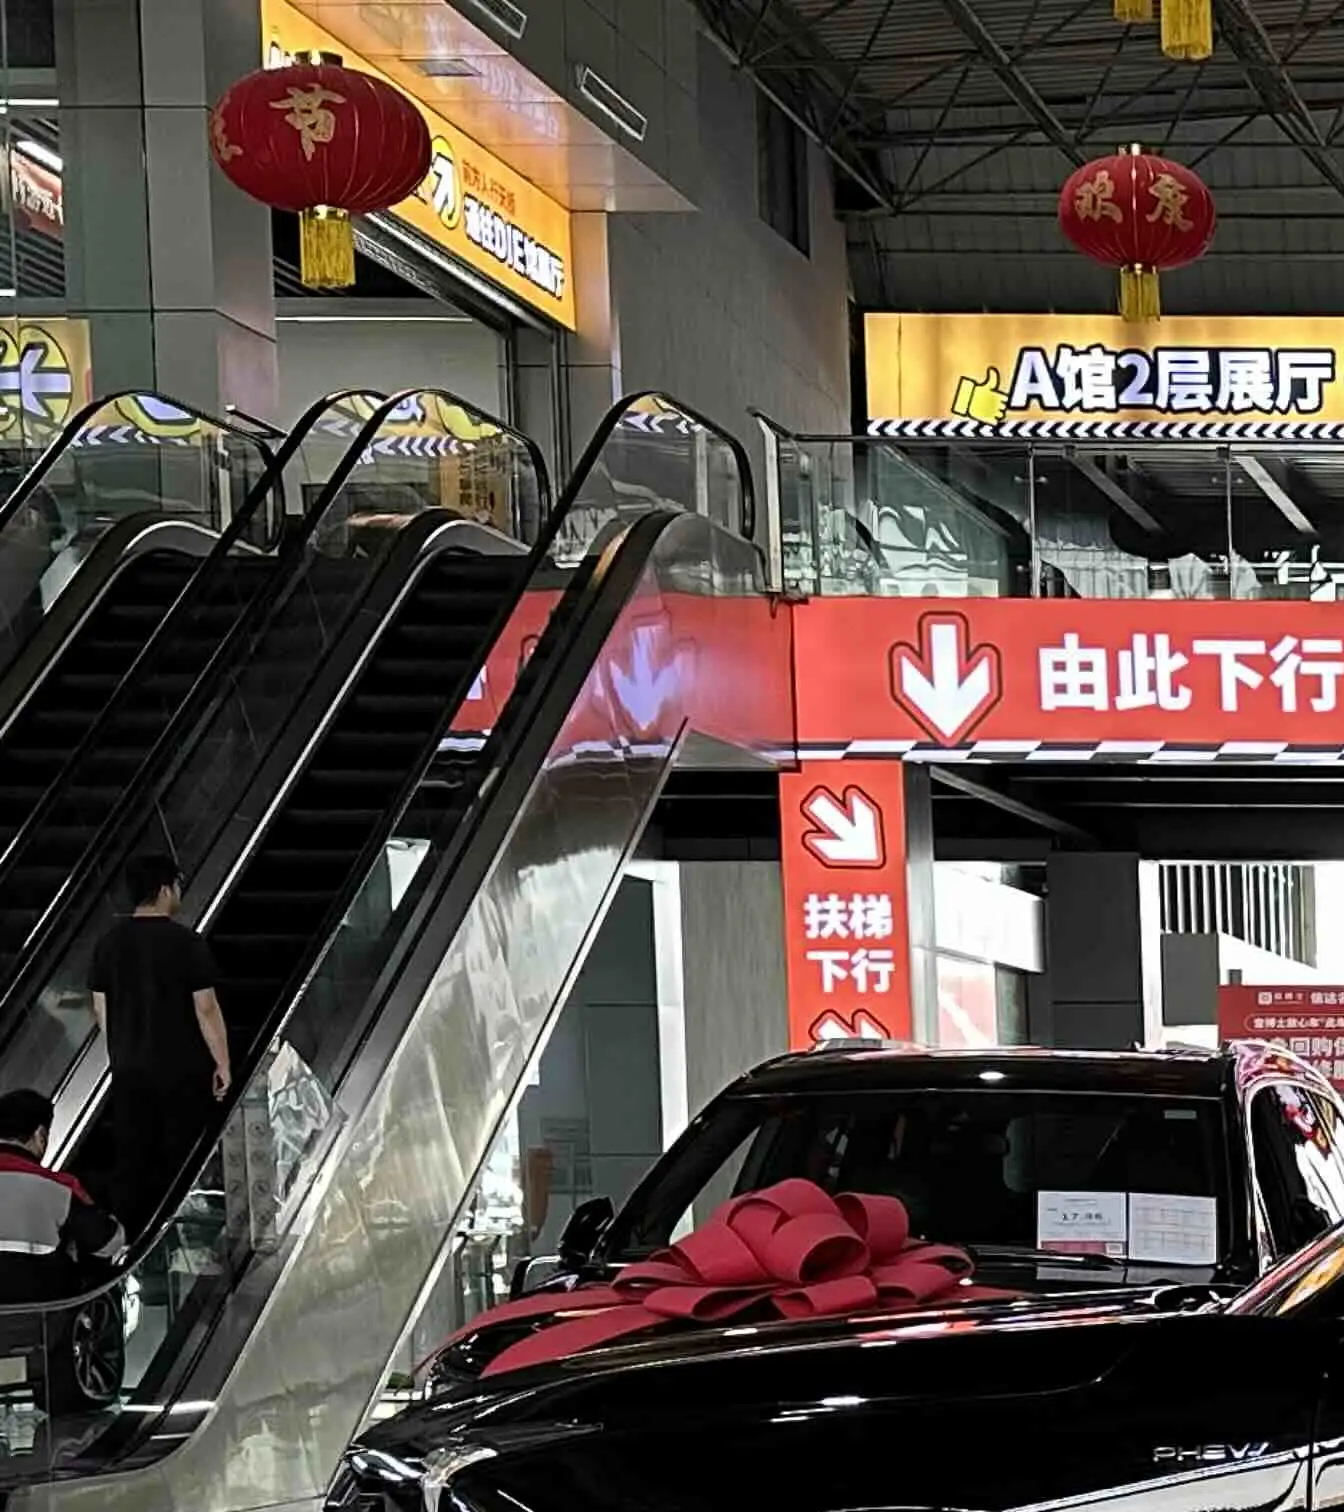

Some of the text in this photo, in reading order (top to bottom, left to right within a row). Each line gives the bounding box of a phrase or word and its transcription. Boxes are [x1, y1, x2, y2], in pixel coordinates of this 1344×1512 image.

[1011, 343, 1335, 415] A馆2层展厅
[802, 893, 893, 941] 扶梯
[805, 948, 895, 994] 下行
